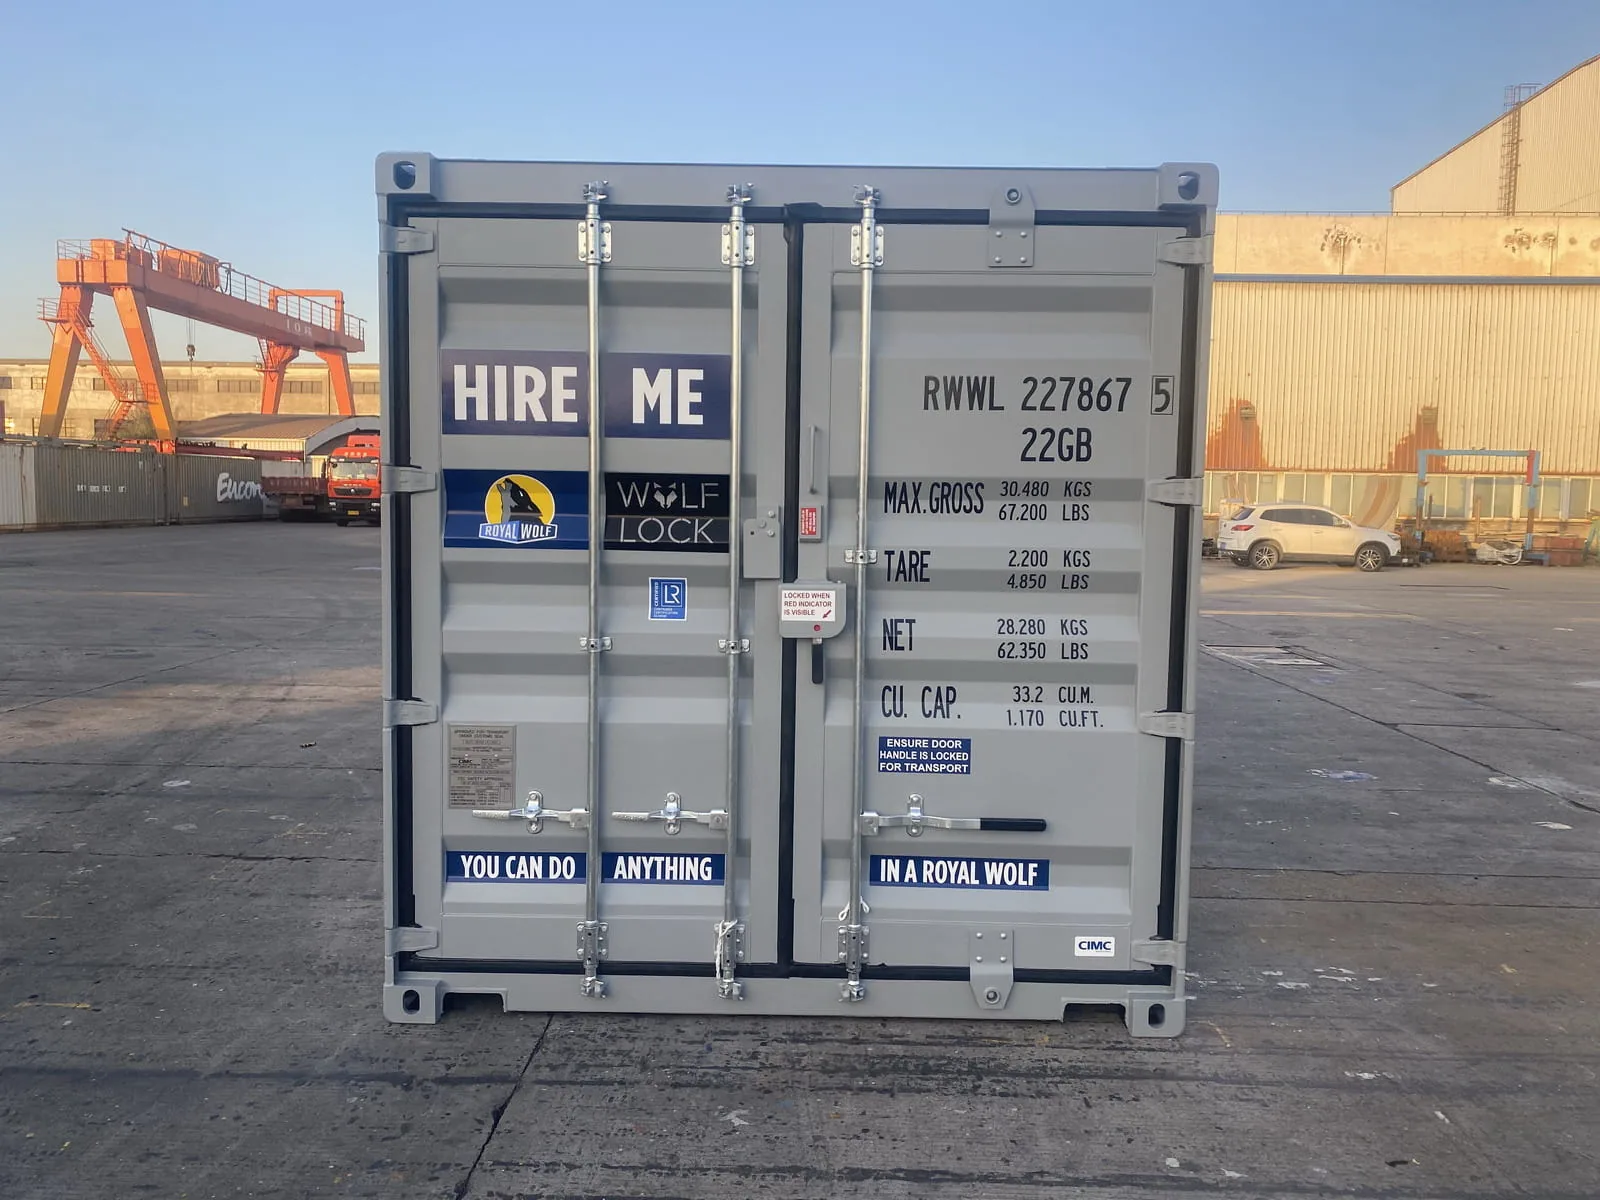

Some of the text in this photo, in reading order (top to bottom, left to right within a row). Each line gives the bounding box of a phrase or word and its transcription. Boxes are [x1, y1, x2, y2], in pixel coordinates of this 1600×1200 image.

[454, 364, 704, 425] HIRE ME
[923, 375, 1171, 413] RWWL 227867 5
[1020, 427, 1092, 462] 22GB
[1064, 481, 1092, 497] KGS
[1062, 504, 1090, 521] LBS
[485, 523, 552, 539] ROYAL WOLF
[619, 517, 715, 544] LOCK
[884, 550, 931, 583] TARE
[1063, 550, 1091, 568] KGS
[1061, 574, 1089, 590] LBS
[664, 584, 680, 604] LR
[882, 618, 916, 651] NET
[1060, 619, 1088, 636] KGS
[1061, 642, 1089, 660] LBS
[881, 685, 961, 719] CU. CAP.
[1012, 686, 1094, 704] 33.2 CU.M.
[1059, 710, 1104, 728] CU.FT.
[887, 738, 962, 749] ENSURE DOOR
[879, 750, 969, 761] HANDLE IS LOCKED
[879, 762, 968, 773] FOR TRANSPORT
[461, 854, 712, 881] YOU CAN DO ANYTHING
[880, 858, 1038, 886] IN A ROYAL WOLF
[1078, 940, 1112, 951] CIMC
